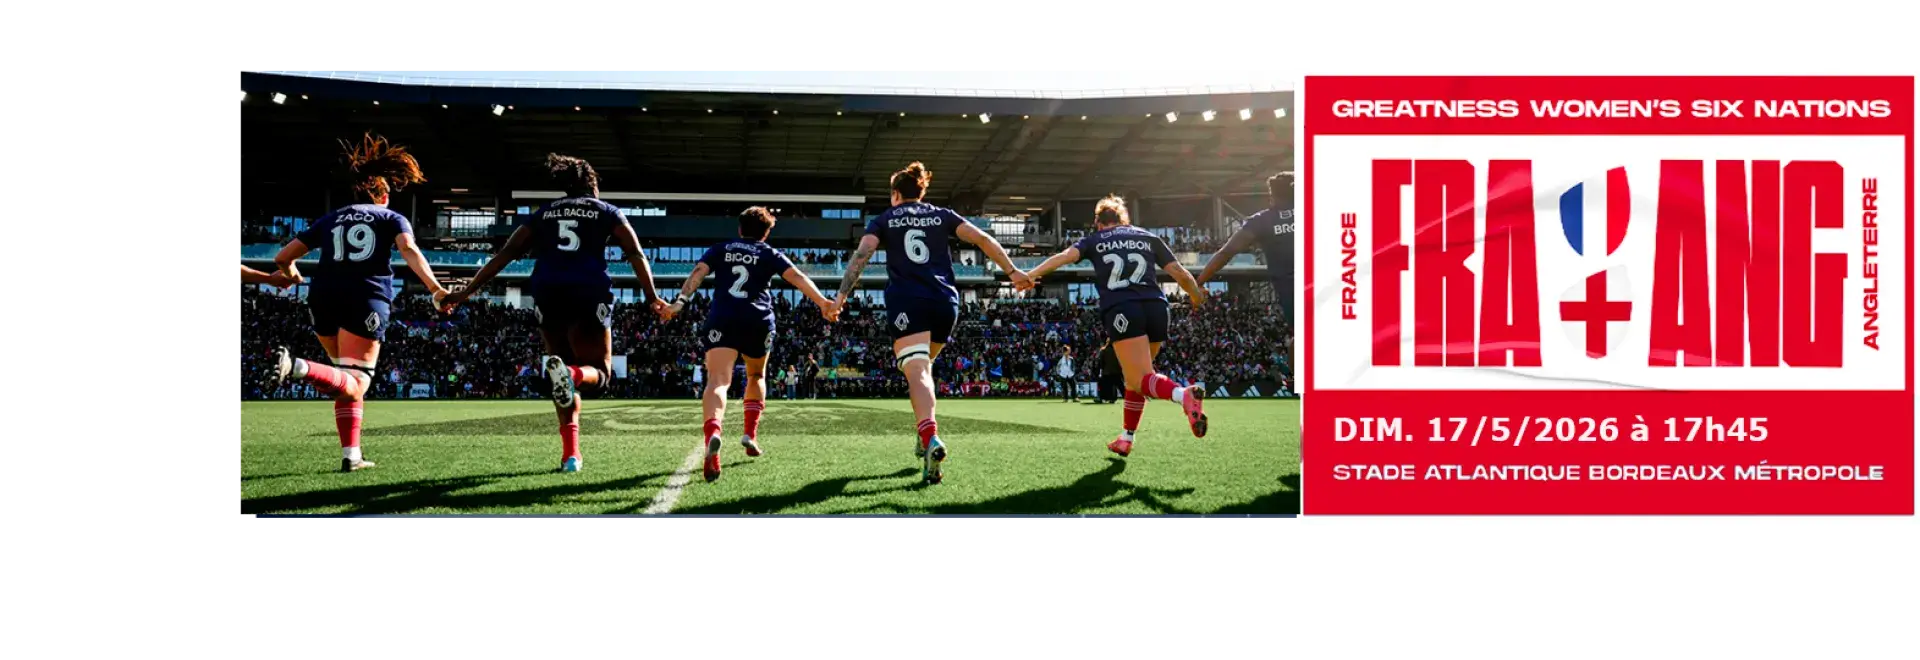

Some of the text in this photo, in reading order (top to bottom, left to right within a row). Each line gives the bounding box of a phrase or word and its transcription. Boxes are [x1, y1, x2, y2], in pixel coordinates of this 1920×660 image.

[564, 208, 599, 219] RACLOT
[888, 216, 942, 228] ESCUDERO
[330, 223, 376, 262] 19
[557, 219, 581, 252] 5
[904, 229, 930, 264] 6
[1095, 240, 1152, 253] CHAMBON
[724, 252, 760, 265] BIGOT
[1102, 252, 1148, 291] 22
[728, 264, 750, 299] 2
